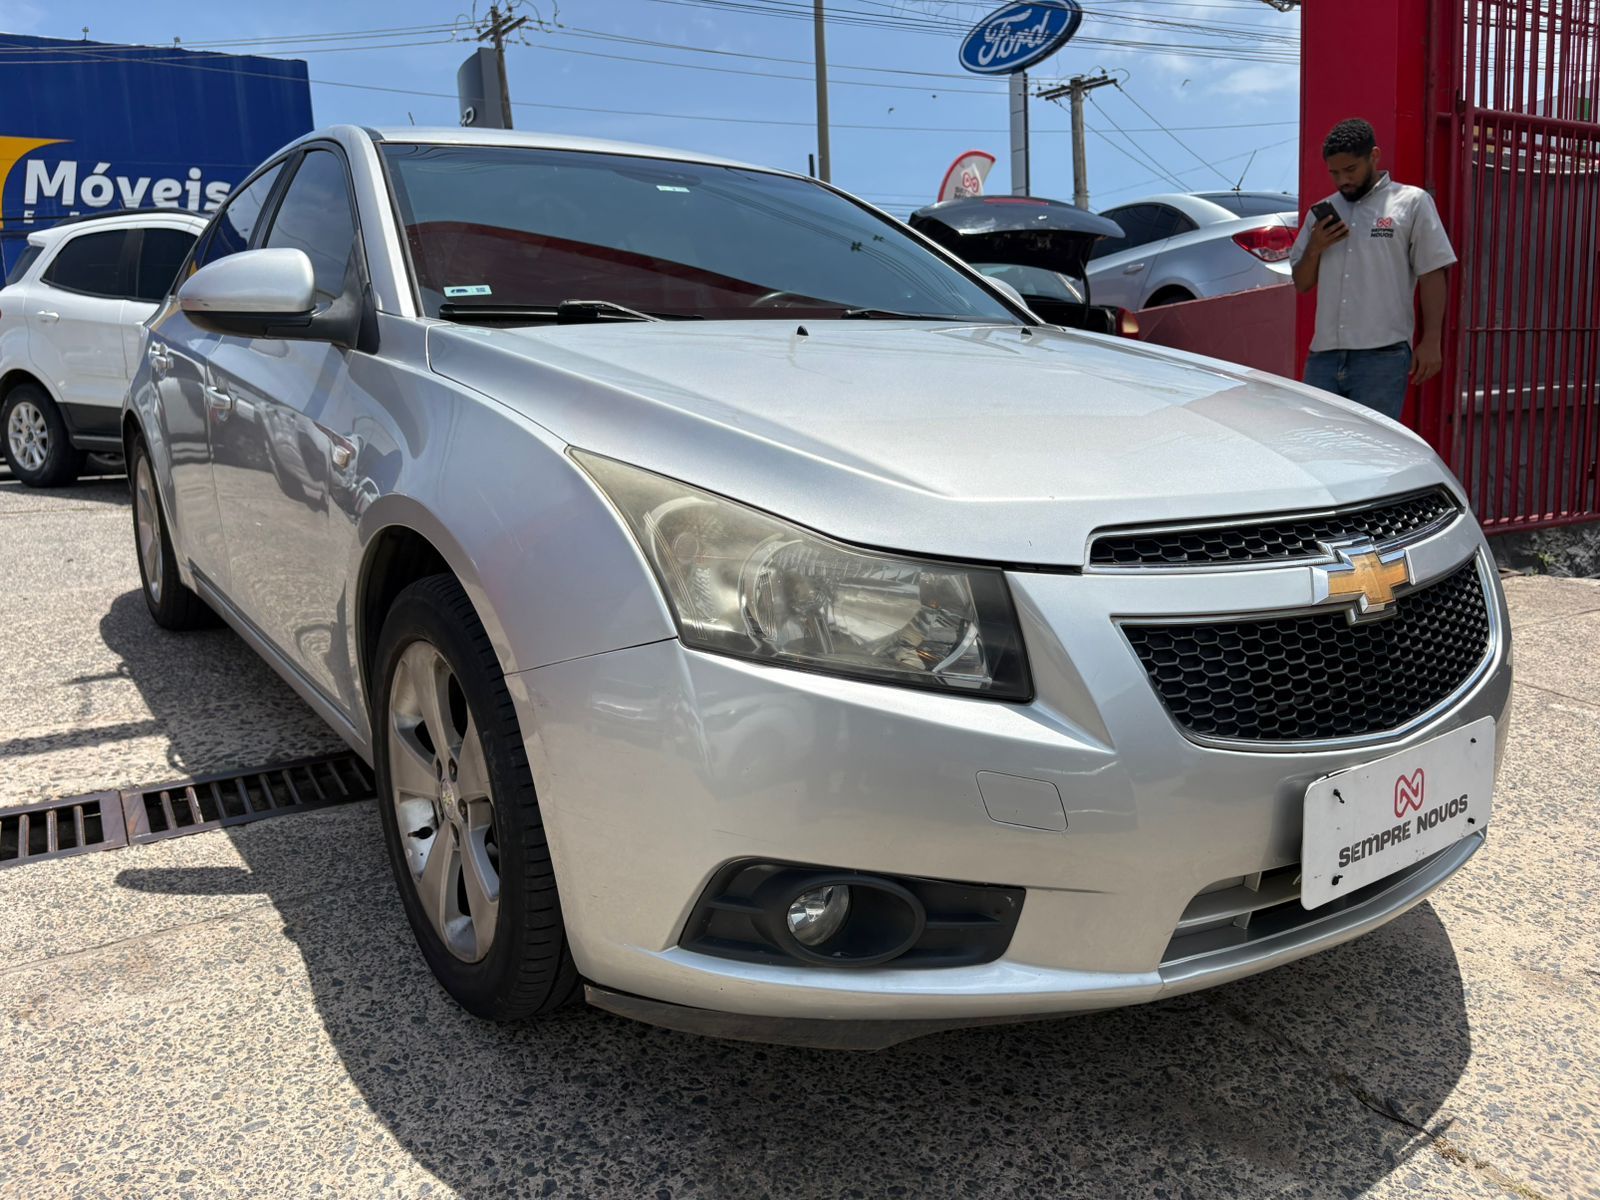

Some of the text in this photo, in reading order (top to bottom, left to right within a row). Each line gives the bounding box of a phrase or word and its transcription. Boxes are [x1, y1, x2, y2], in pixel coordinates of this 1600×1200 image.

[978, 8, 1051, 65] Ford
[24, 159, 231, 212] Móveis
[1338, 820, 1411, 868] SEMPRE
